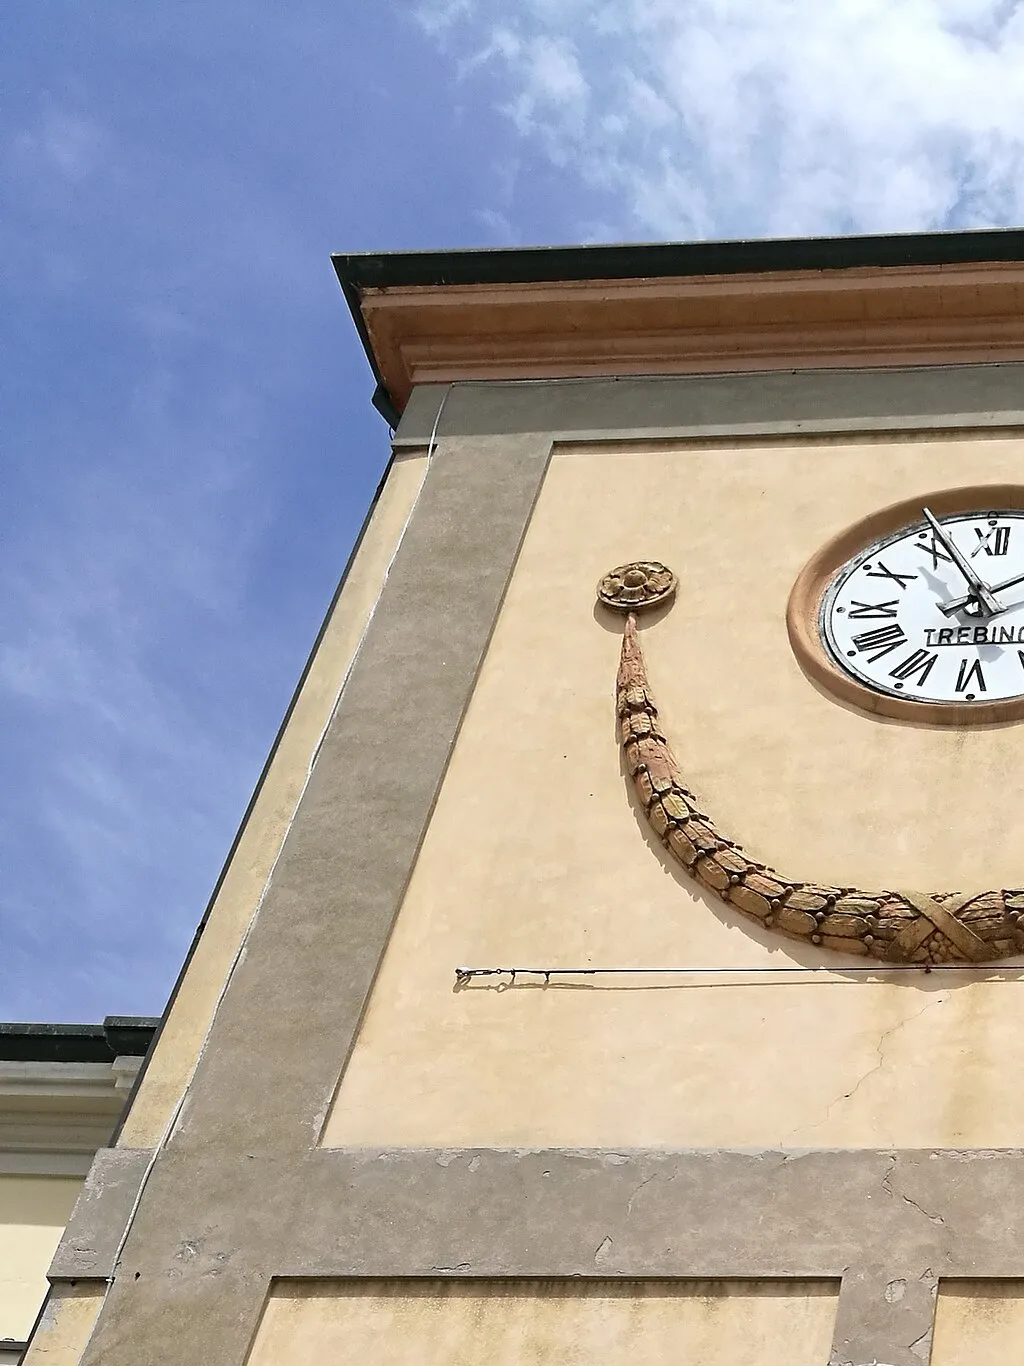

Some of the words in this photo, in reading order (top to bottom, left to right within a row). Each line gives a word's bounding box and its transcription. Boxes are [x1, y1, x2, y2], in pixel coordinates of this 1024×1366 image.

[970, 527, 1011, 558] XII
[866, 561, 919, 590] X
[848, 599, 900, 619] IX
[851, 623, 908, 664] VIII
[888, 648, 938, 687] VII
[955, 659, 987, 692] VI
